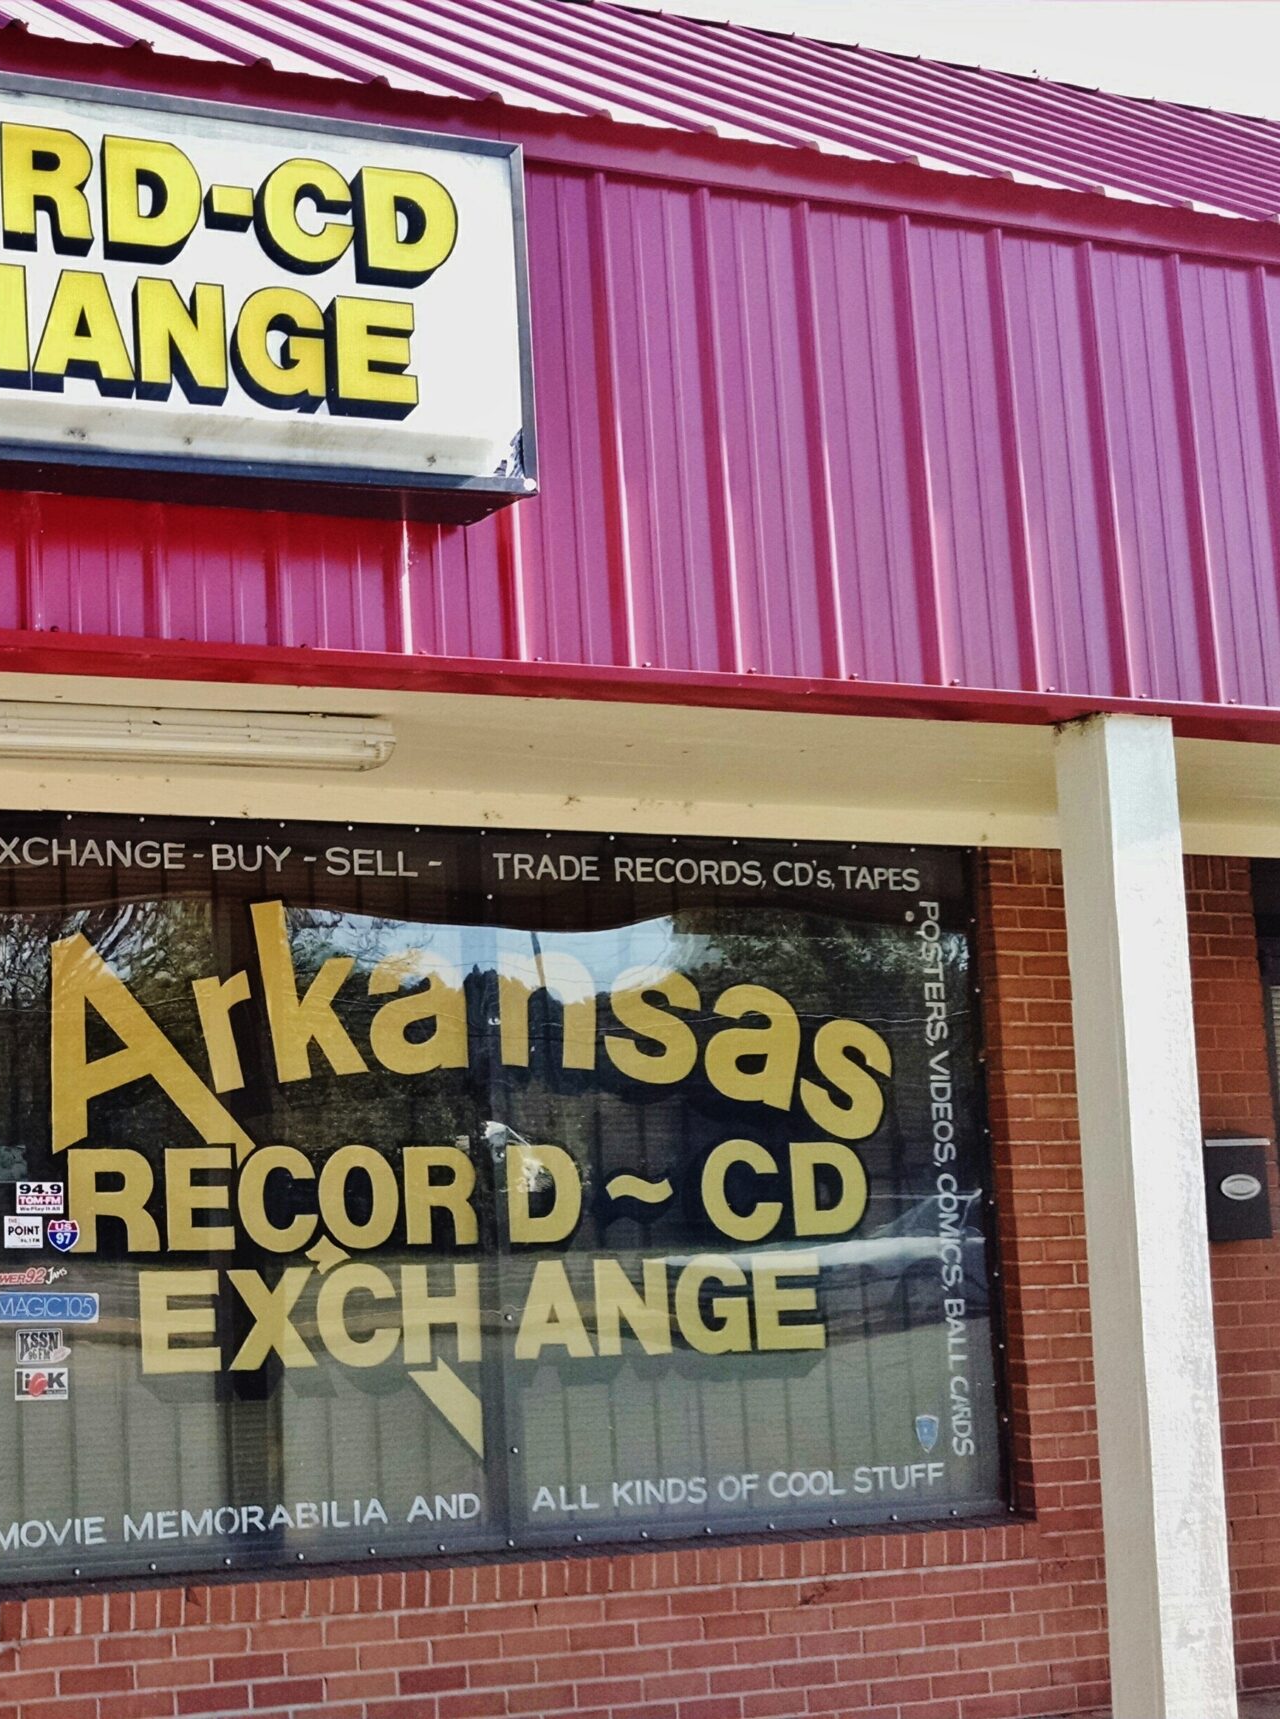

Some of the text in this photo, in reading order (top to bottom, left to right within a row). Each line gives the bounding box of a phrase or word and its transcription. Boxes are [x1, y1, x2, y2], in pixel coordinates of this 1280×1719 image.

[325, 846, 419, 878] SELL
[492, 852, 600, 882] TRADE
[614, 856, 767, 890] RECORDS,
[838, 864, 920, 893] TAPES
[51, 899, 893, 1168] Arkansas
[19, 1184, 62, 1195] 94.9
[67, 1144, 583, 1254] RECORD
[700, 1138, 869, 1243] CD
[918, 900, 975, 1457] POSTERS, VIDEOS, COMICS, BALL CARDS
[8, 1226, 40, 1236] POINT
[55, 1233, 72, 1245] 97
[138, 1252, 827, 1375] EXCHANGE
[19, 1331, 59, 1361] KSSN
[123, 1498, 389, 1543] MEMORABILIA
[406, 1492, 482, 1524] AND
[531, 1485, 600, 1513] ALL
[611, 1475, 709, 1508] KINDS
[718, 1474, 760, 1502] OF
[767, 1469, 846, 1498] COOL
[853, 1462, 945, 1493] STUFF
